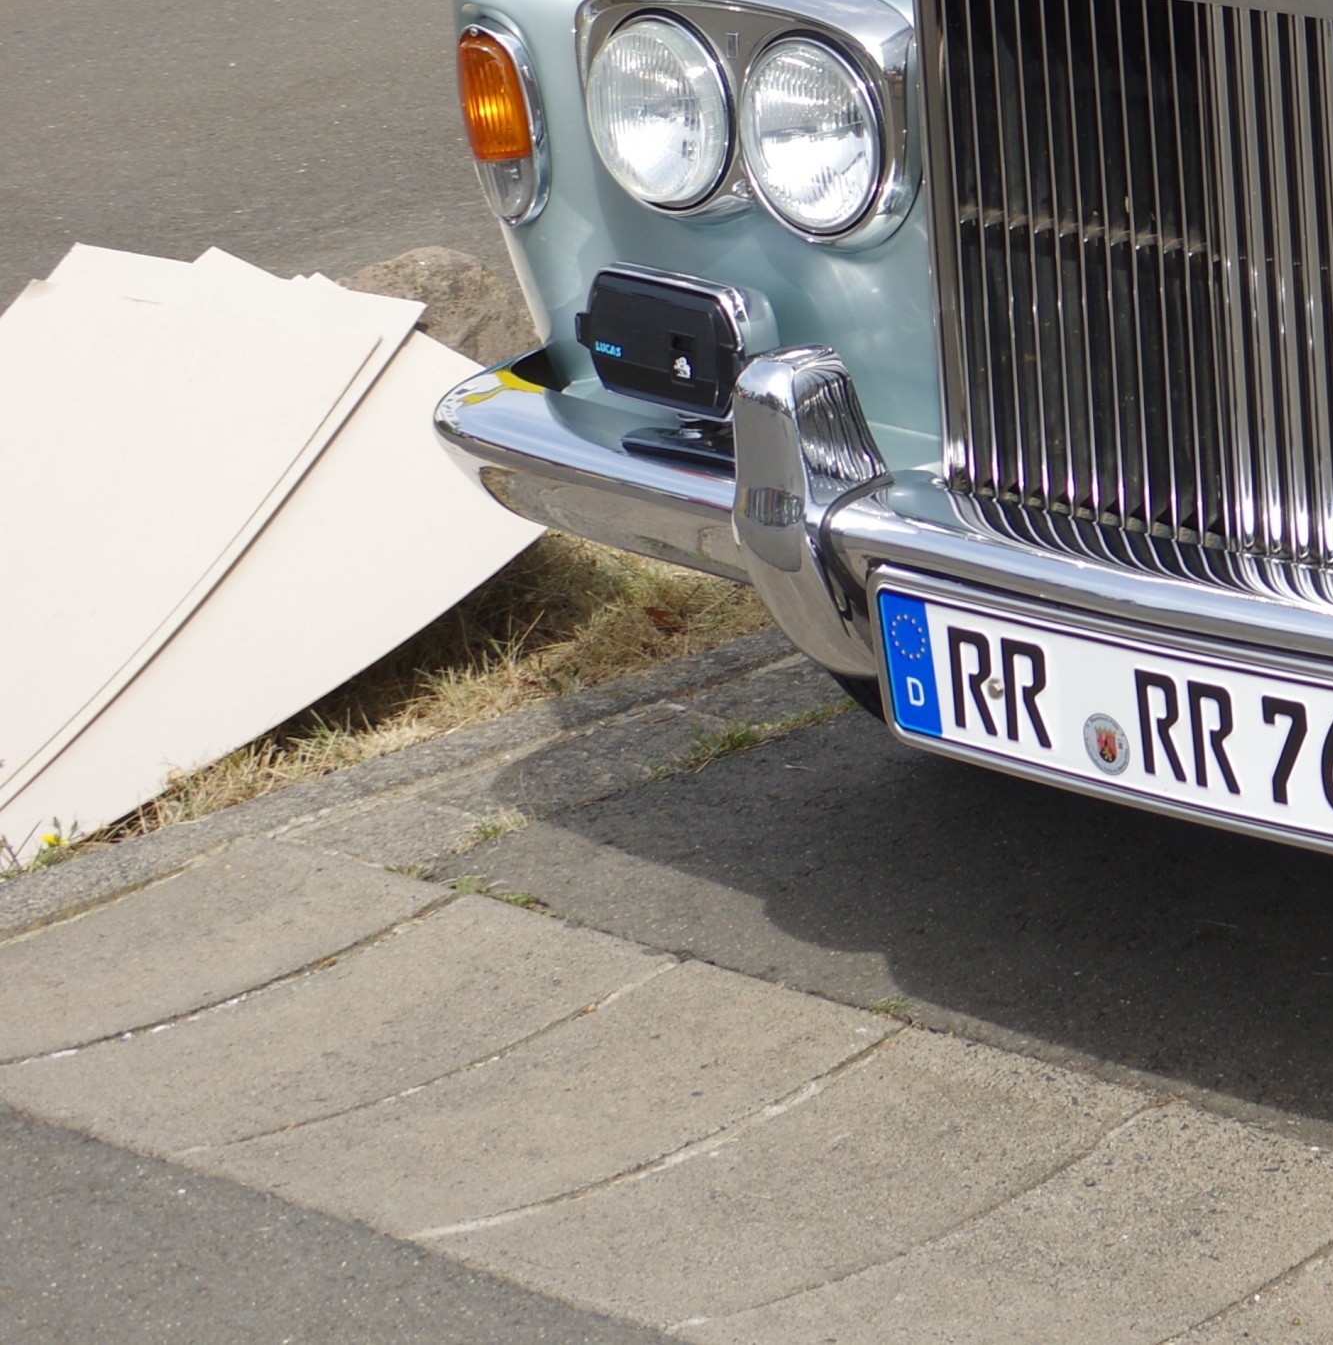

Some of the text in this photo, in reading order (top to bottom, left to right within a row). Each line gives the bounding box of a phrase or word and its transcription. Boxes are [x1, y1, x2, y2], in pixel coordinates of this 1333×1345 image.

[595, 341, 621, 357] LUCAS
[906, 675, 925, 708] D
[947, 625, 1053, 750] RR
[1134, 667, 1242, 796] RR
